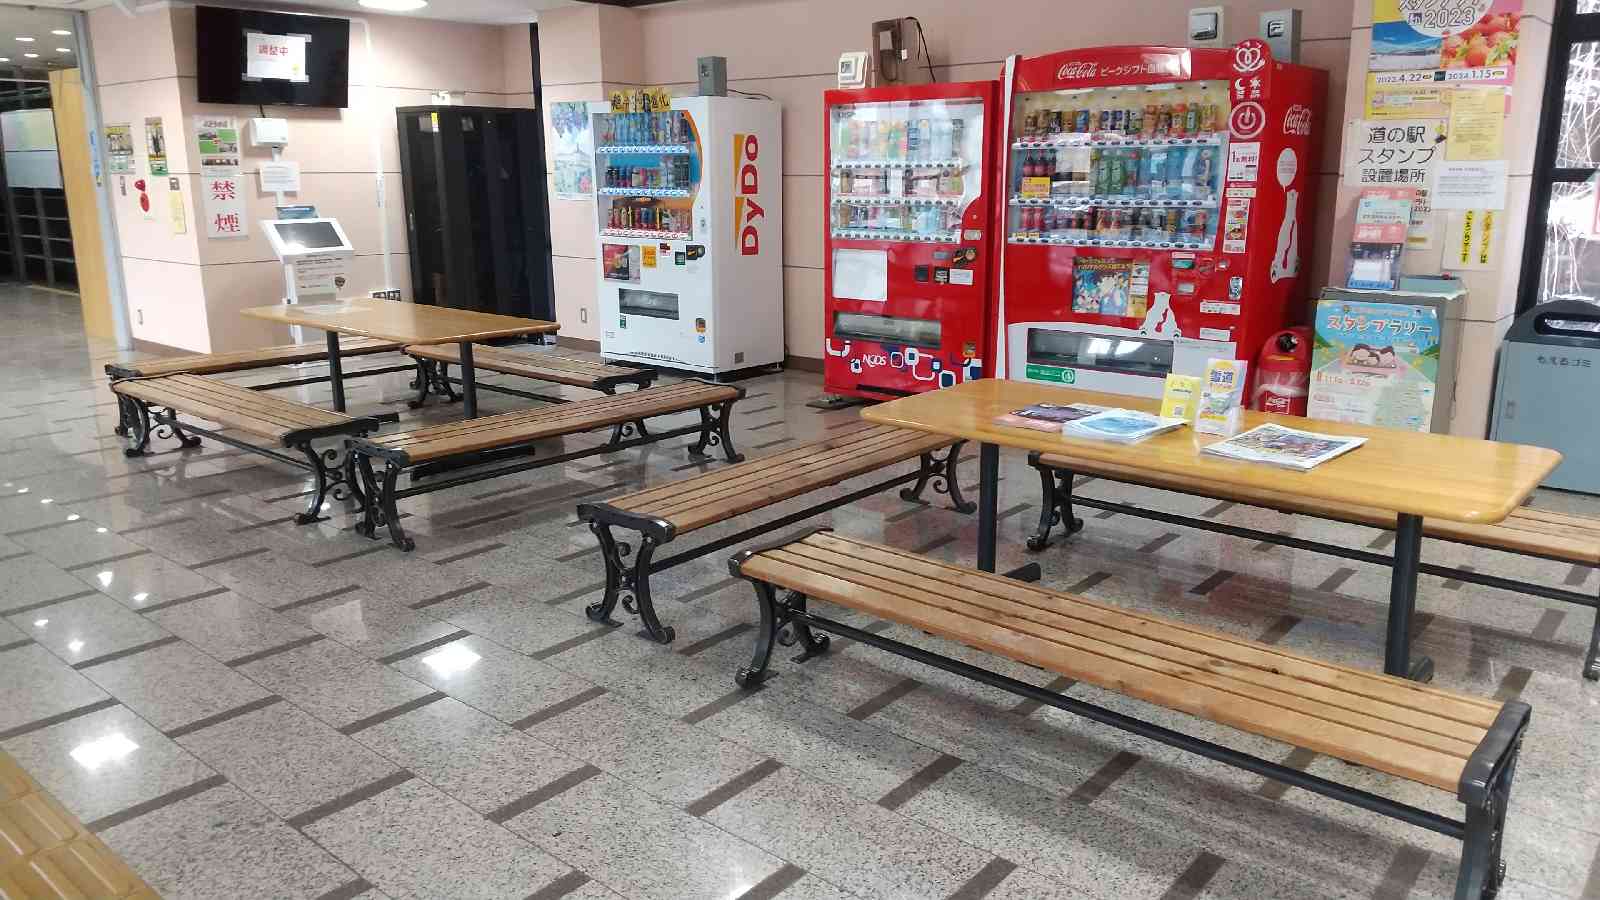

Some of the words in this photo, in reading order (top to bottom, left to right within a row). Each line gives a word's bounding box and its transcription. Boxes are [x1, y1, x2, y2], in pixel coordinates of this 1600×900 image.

[1424, 7, 1475, 28] 2023
[256, 44, 288, 57] 調整中
[1057, 61, 1099, 80] Coca-Cola
[1367, 125, 1426, 144] 道の駅
[1358, 145, 1437, 165] スタンプ
[1361, 168, 1425, 183] 設置場所
[211, 181, 240, 232] 禁煙
[1327, 314, 1433, 336] スタンプラリー
